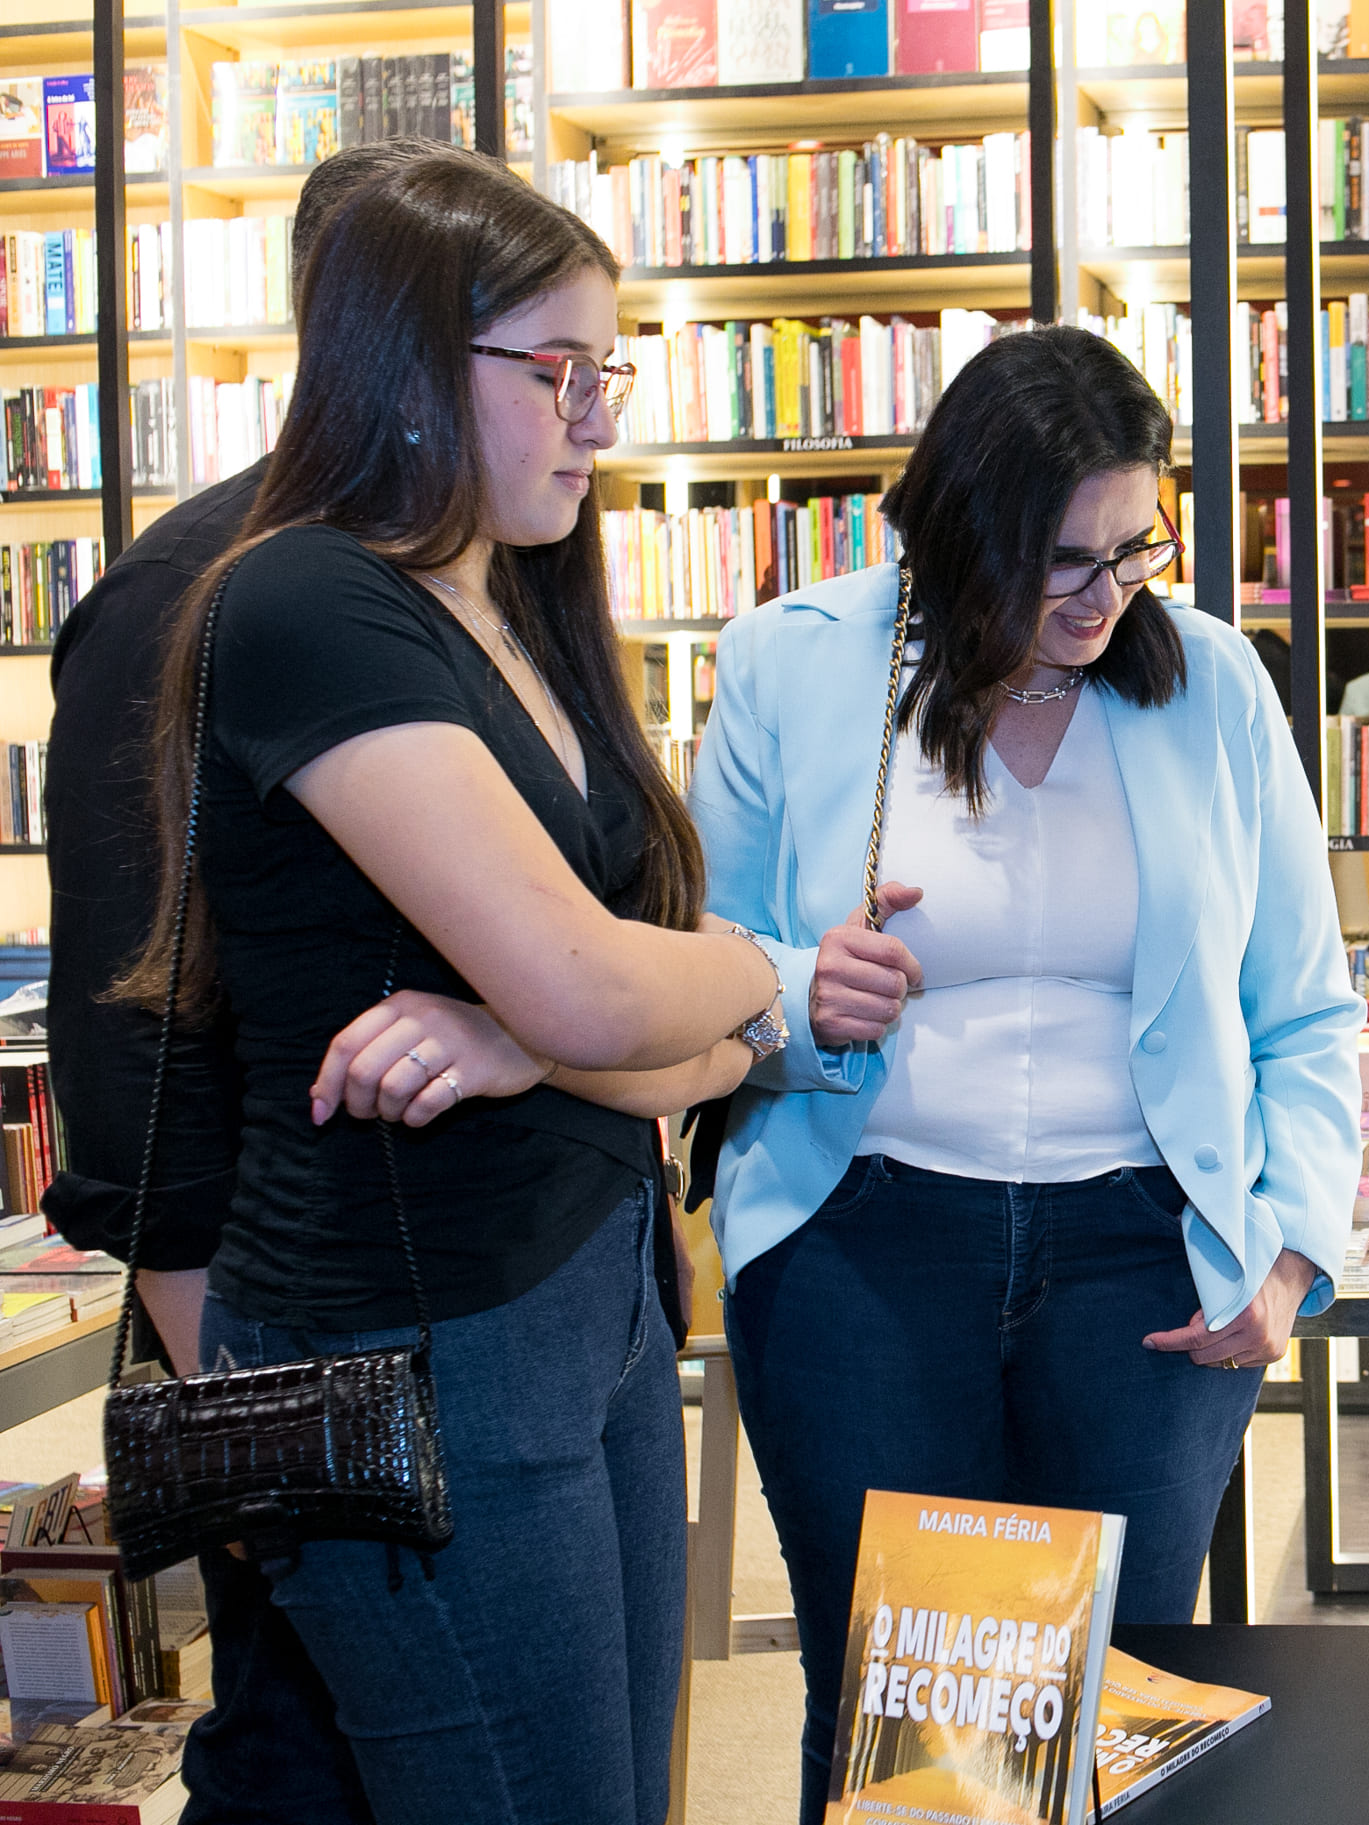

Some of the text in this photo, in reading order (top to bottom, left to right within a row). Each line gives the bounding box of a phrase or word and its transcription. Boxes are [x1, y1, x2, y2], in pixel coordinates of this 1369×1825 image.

[782, 437, 854, 451] FILOSOFIA
[919, 1510, 1051, 1544] MAIRA FÉRIA
[873, 1604, 1071, 1676] O MILAGRE DO
[863, 1661, 1063, 1753] RECOMEÇO
[1160, 1727, 1229, 1777] O MILAGRE DO RECOMEÇO
[856, 1800, 908, 1817] LIBERTE-SE
[909, 1807, 924, 1819] DO
[925, 1809, 971, 1825] PASSADO
[1114, 1791, 1130, 1809] FÉRIA
